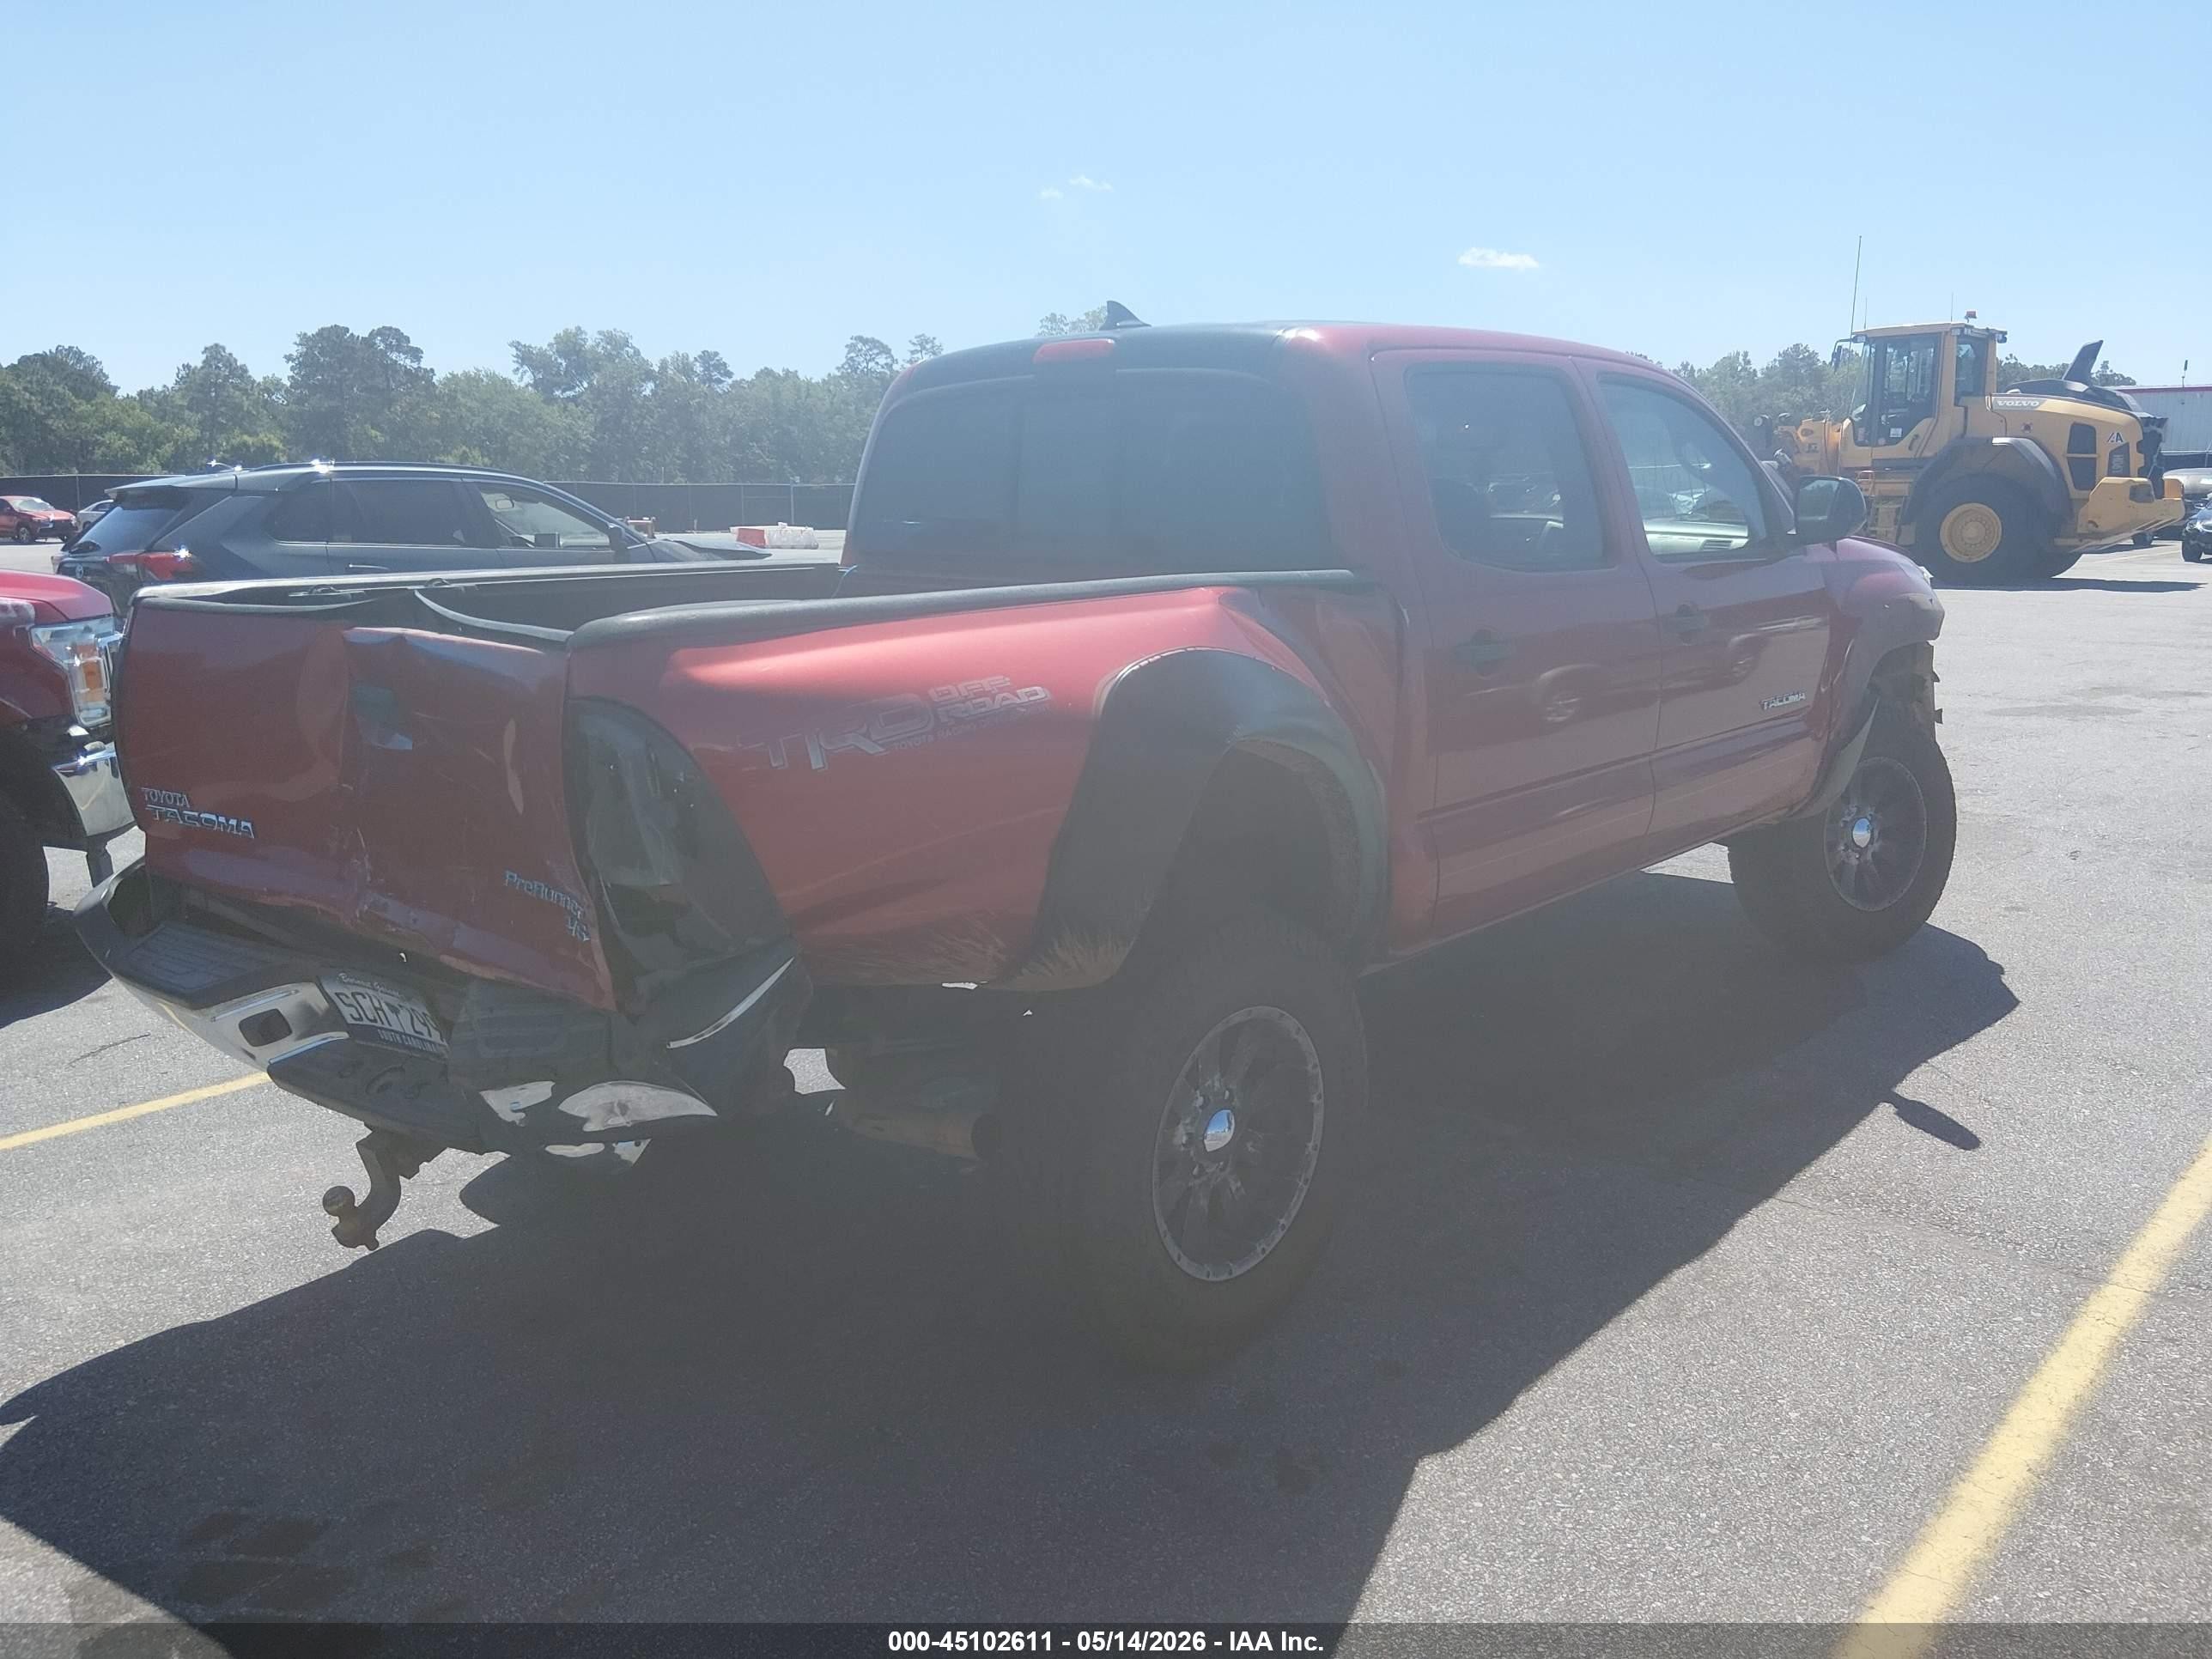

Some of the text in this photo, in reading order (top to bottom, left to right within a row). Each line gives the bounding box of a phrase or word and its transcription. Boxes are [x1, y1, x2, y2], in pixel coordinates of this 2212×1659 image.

[927, 675, 1011, 702] OFF
[936, 686, 1051, 724] ROAD
[1759, 692, 1806, 710] TACOMA
[738, 692, 935, 771] TRD
[141, 787, 190, 808] TOYOTA
[145, 804, 255, 839] TACOMA
[503, 869, 584, 920] PreRunner
[335, 991, 392, 1027] SCH
